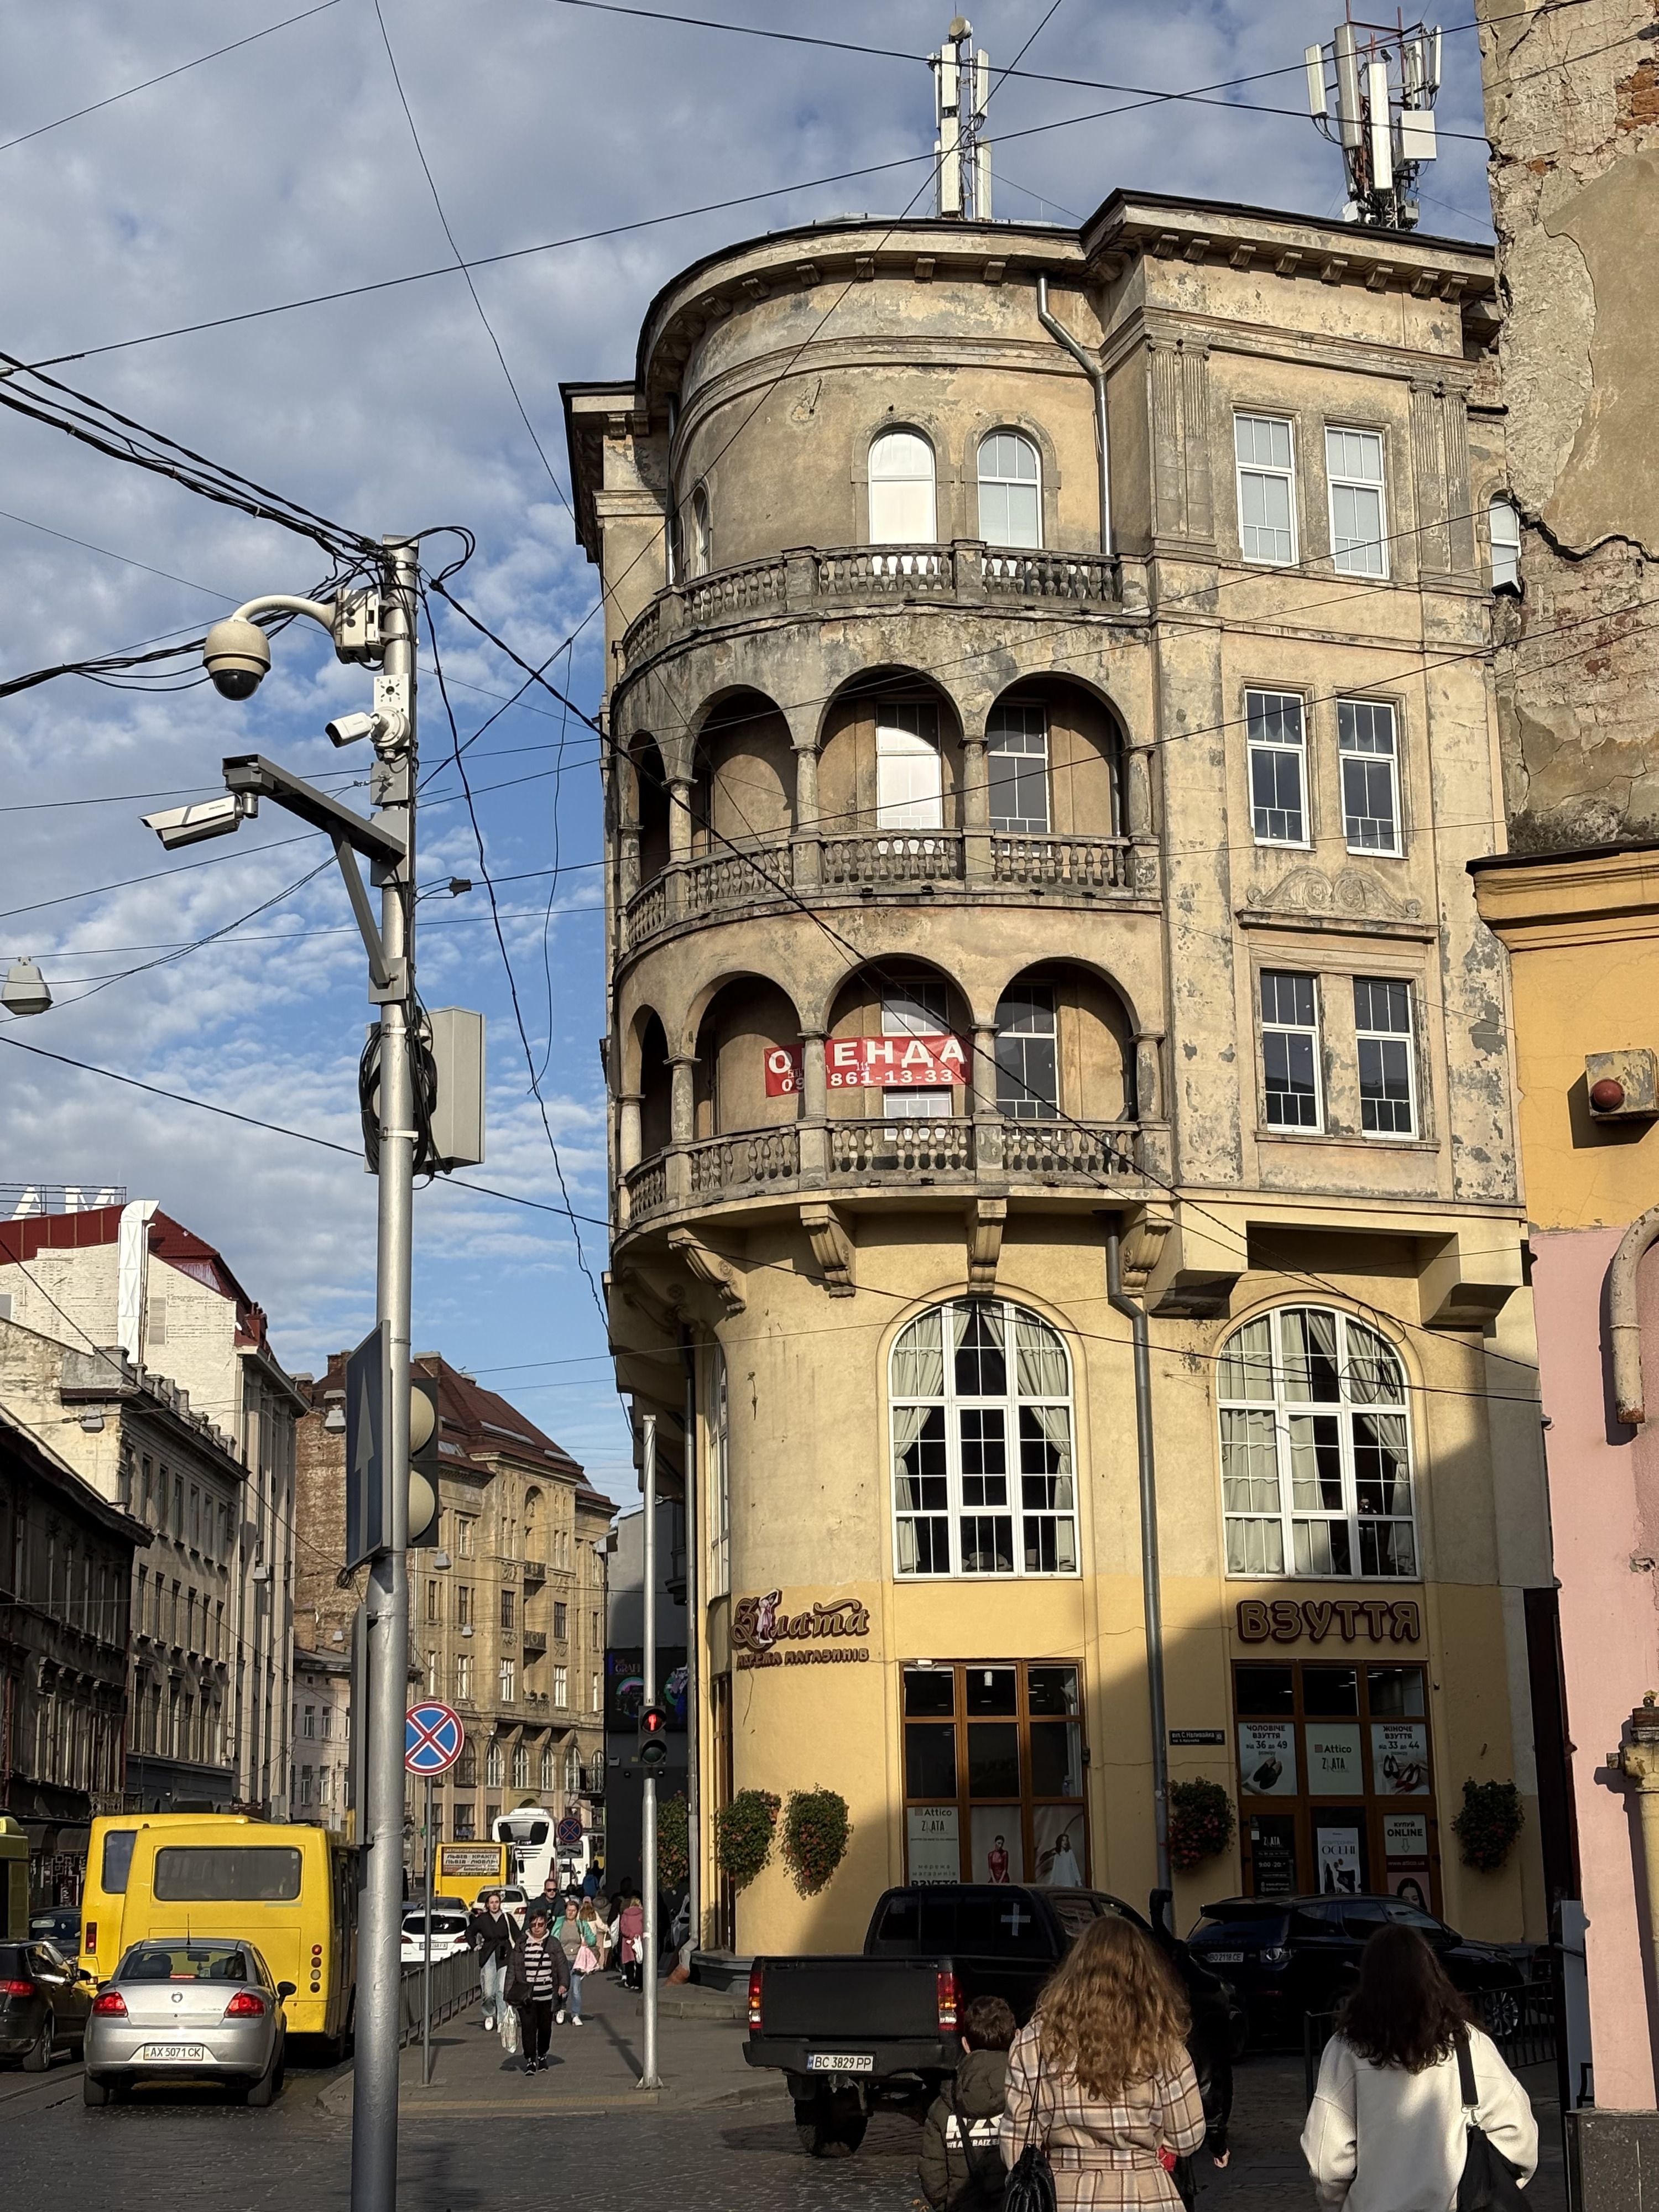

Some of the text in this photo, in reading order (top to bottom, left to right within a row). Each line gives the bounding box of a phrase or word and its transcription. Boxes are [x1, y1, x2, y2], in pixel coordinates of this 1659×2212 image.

[769, 1039, 966, 1074] ОЕНДА
[830, 1070, 953, 1087] 861-13-33
[1237, 1600, 1420, 1643] ВЗУТТЯ
[784, 1648, 870, 1666] МАГАЗИНІВ
[1256, 1740, 1266, 1749] 36
[1277, 1740, 1287, 1749] 49
[1324, 1744, 1352, 1753] Attico
[1388, 1741, 1398, 1749] 33
[1408, 1741, 1420, 1749] 44
[924, 1808, 952, 1816] Attico
[1387, 1828, 1423, 1837] ONLINE
[150, 2047, 201, 2058] AX 5071 CK
[815, 2056, 872, 2069] BC 3829 PP
